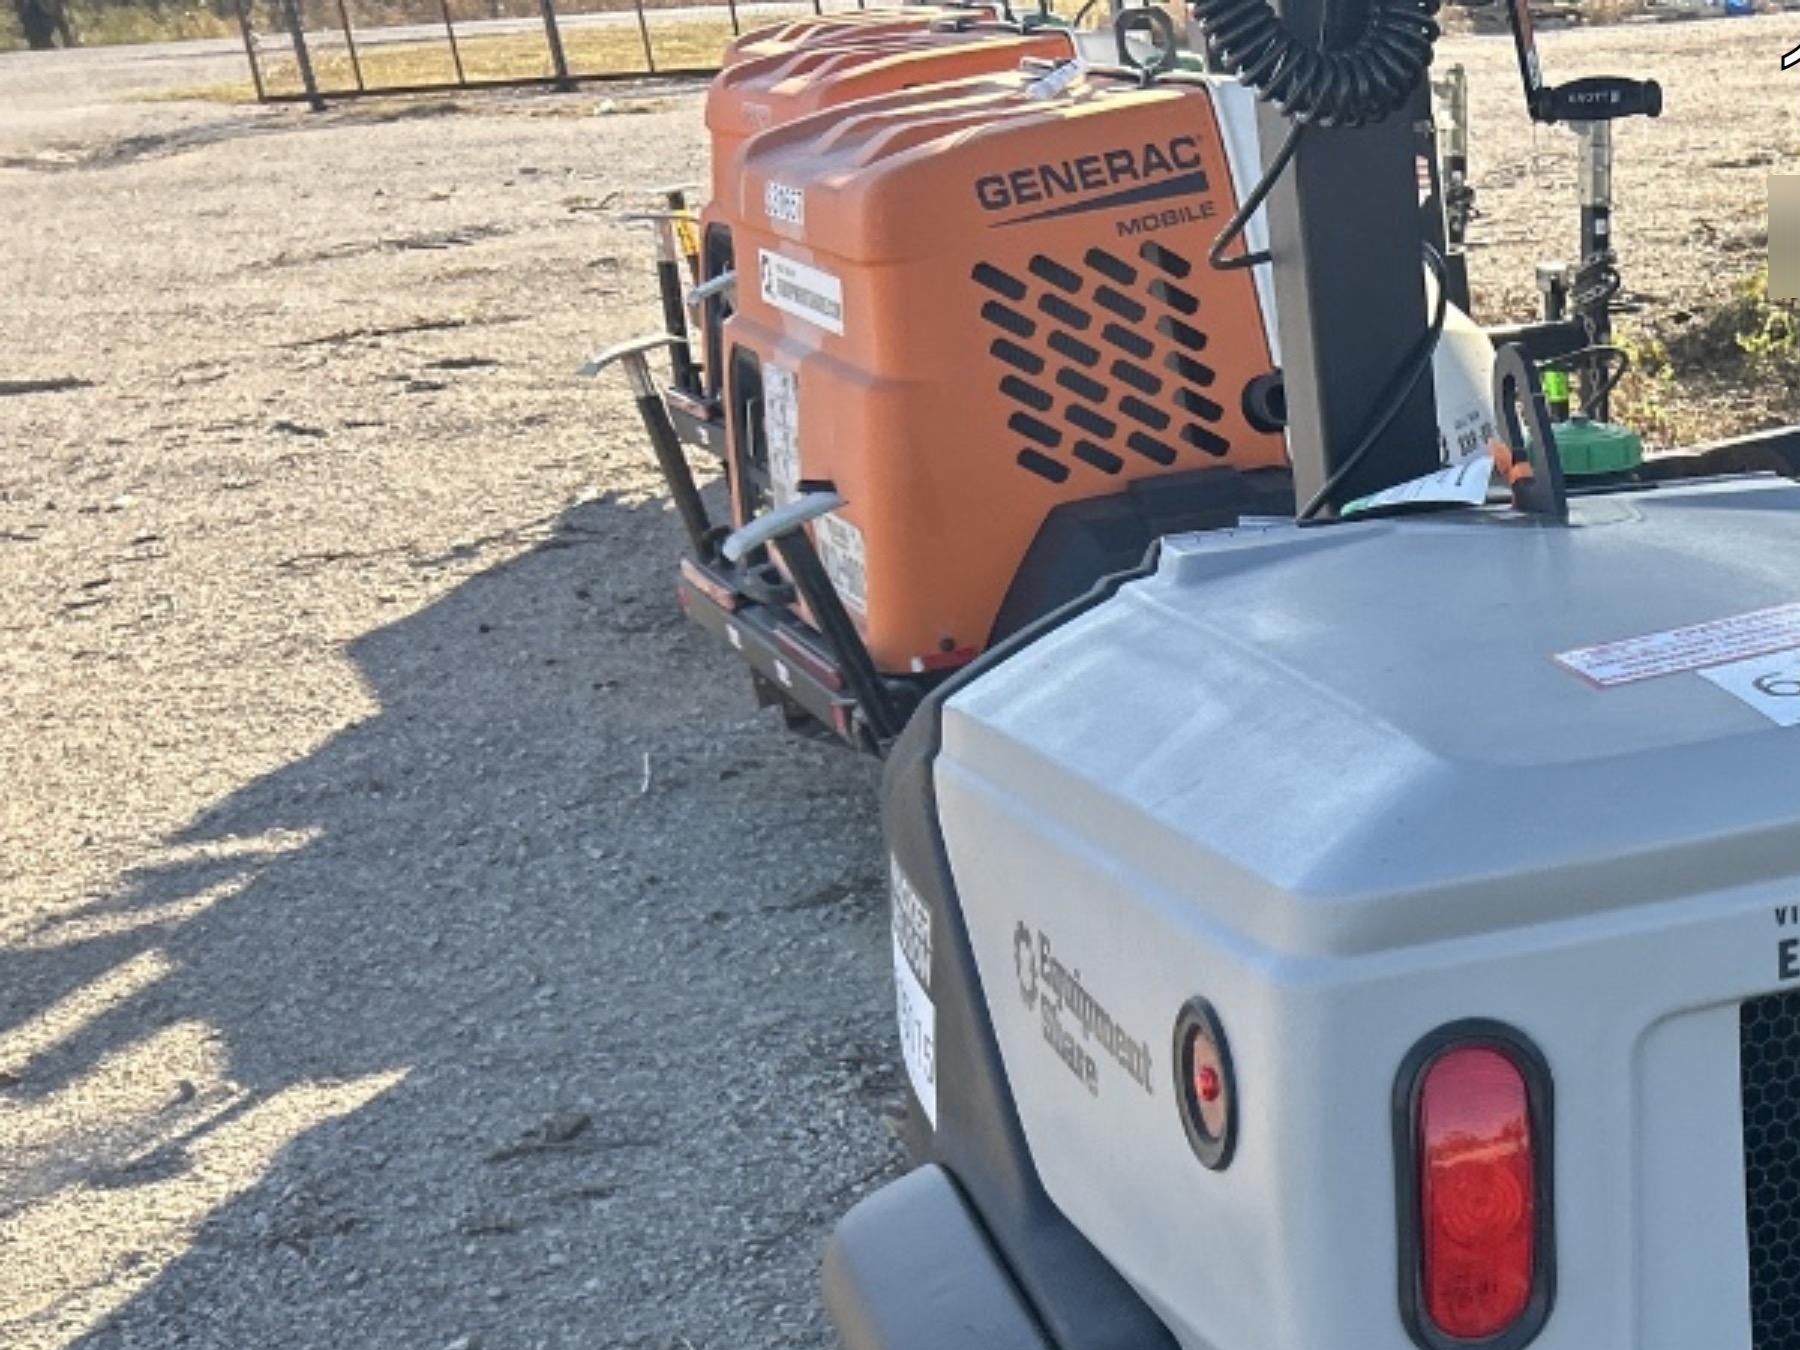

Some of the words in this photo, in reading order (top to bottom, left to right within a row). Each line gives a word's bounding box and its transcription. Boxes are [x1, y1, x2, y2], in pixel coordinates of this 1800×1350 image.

[974, 135, 1202, 211] GENERAC
[1115, 200, 1217, 238] MOBILE
[1037, 928, 1153, 1098] Equipment
[1040, 992, 1098, 1098] Share
